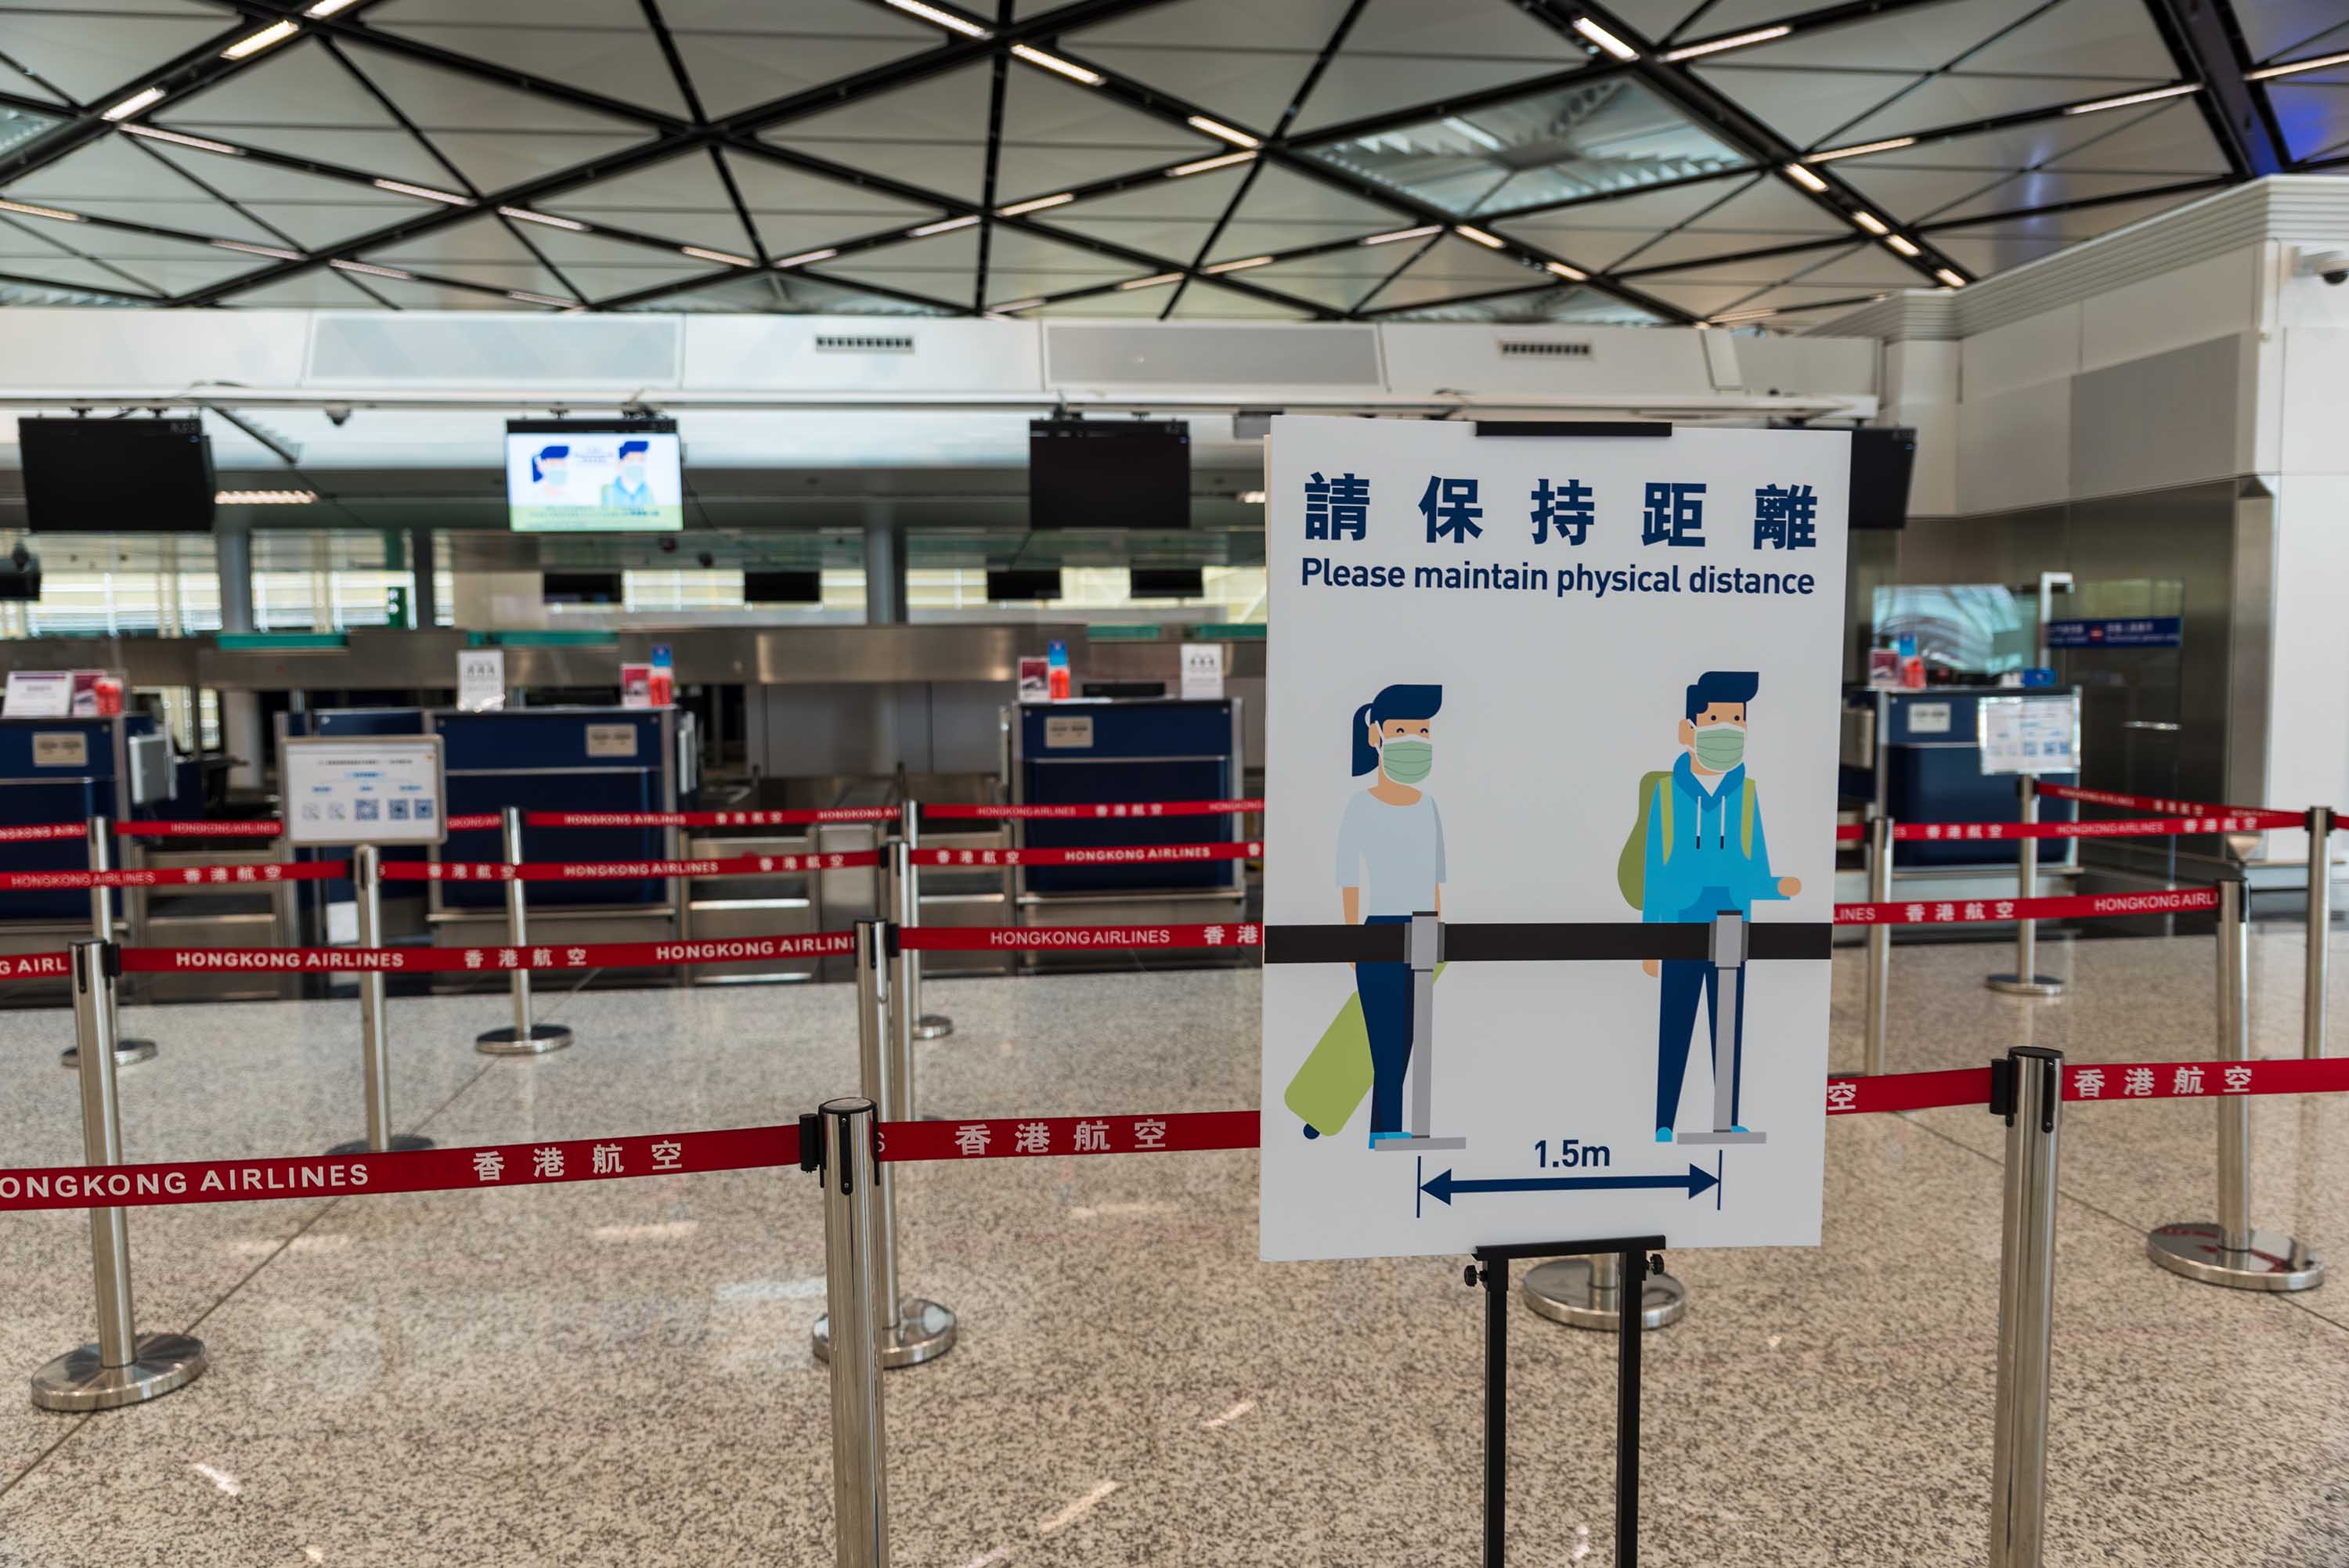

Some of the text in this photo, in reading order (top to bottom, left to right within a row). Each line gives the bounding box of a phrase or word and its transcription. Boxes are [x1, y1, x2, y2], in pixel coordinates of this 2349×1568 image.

[1304, 471, 1817, 550] 請保持距離
[1302, 557, 1814, 597] Please maintain physical distance
[1906, 901, 2014, 922] 香港航空
[2095, 896, 2180, 912] HONGKONG
[656, 941, 774, 961] HONGKONG
[990, 929, 1171, 946] HONGKONG AIRLINES
[175, 952, 404, 968] HONGKONG AIRLINES
[464, 948, 588, 969] 香港航空
[2074, 1065, 2253, 1098] 香港航空
[954, 1118, 1167, 1156] 香港航空
[473, 1140, 683, 1182] 香港航空
[1534, 1139, 1611, 1169] 1.5m
[200, 1163, 369, 1192] AIRLINES
